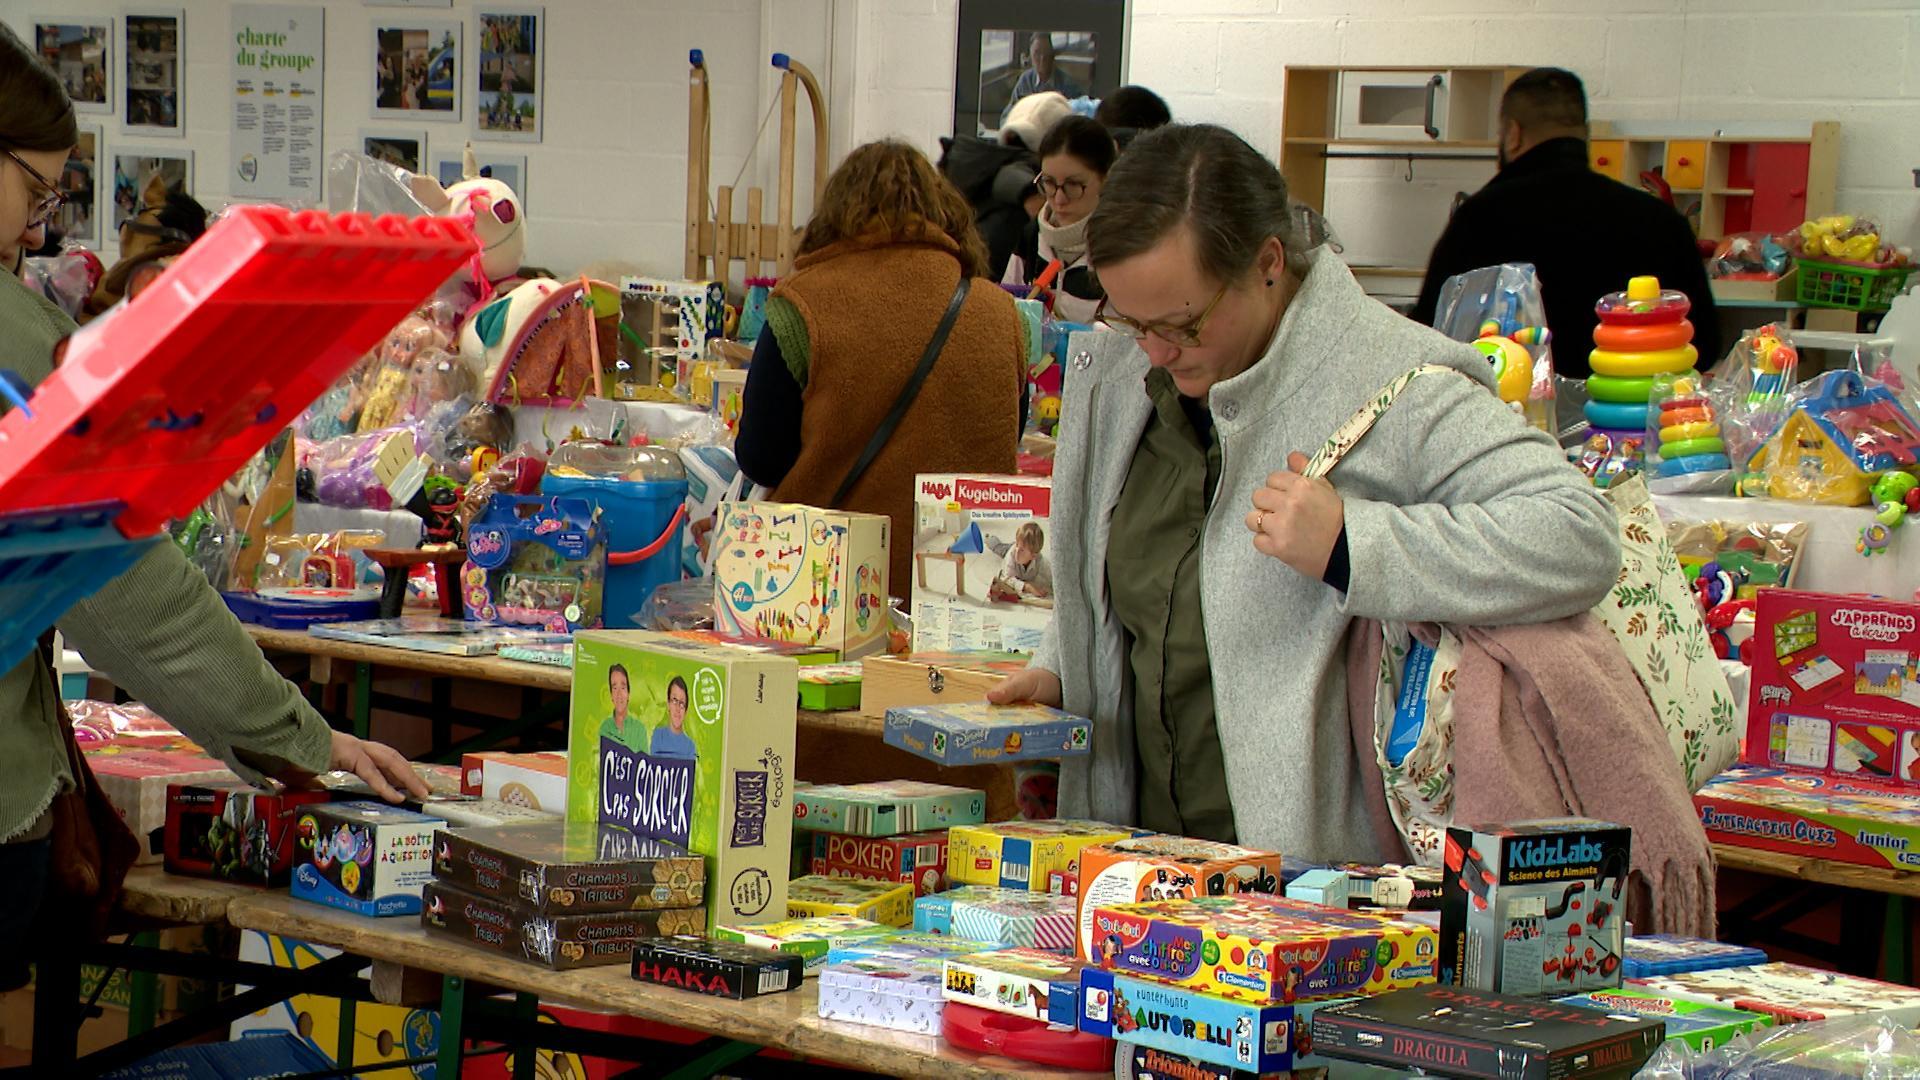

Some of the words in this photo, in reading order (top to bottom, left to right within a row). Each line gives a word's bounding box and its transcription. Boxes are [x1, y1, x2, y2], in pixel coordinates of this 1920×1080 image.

[236, 26, 287, 47] charte
[237, 46, 256, 66] du
[260, 49, 315, 73] groupe
[921, 481, 952, 500] HABA
[958, 485, 1023, 503] Kugelbahn
[1833, 610, 1914, 631] J'APPRENDS
[763, 747, 784, 808] écologie
[613, 793, 631, 820] PAS
[633, 758, 688, 836] SORCIER
[1701, 806, 1792, 836] INTERACTIVE
[1794, 820, 1836, 844] QUIZ
[1855, 830, 1910, 850] Junior
[391, 836, 403, 848] LA
[829, 835, 894, 872] POKER
[1509, 836, 1603, 868] KidzLabs
[567, 872, 628, 887] CHAMANS
[1508, 870, 1543, 882] Science
[1545, 869, 1561, 878] des
[1563, 866, 1598, 878] Aimants
[474, 923, 504, 946] TRIBUS
[577, 925, 634, 941] CHAMANS
[1173, 935, 1196, 952] Mes
[1128, 953, 1150, 967] avec
[1142, 939, 1191, 962] chiffres
[639, 960, 731, 995] HAKA
[1309, 978, 1328, 989] avec
[1136, 1006, 1232, 1048] AUTORELLI
[1393, 1036, 1469, 1067] DRACULA
[1593, 1040, 1633, 1068] DRACULA
